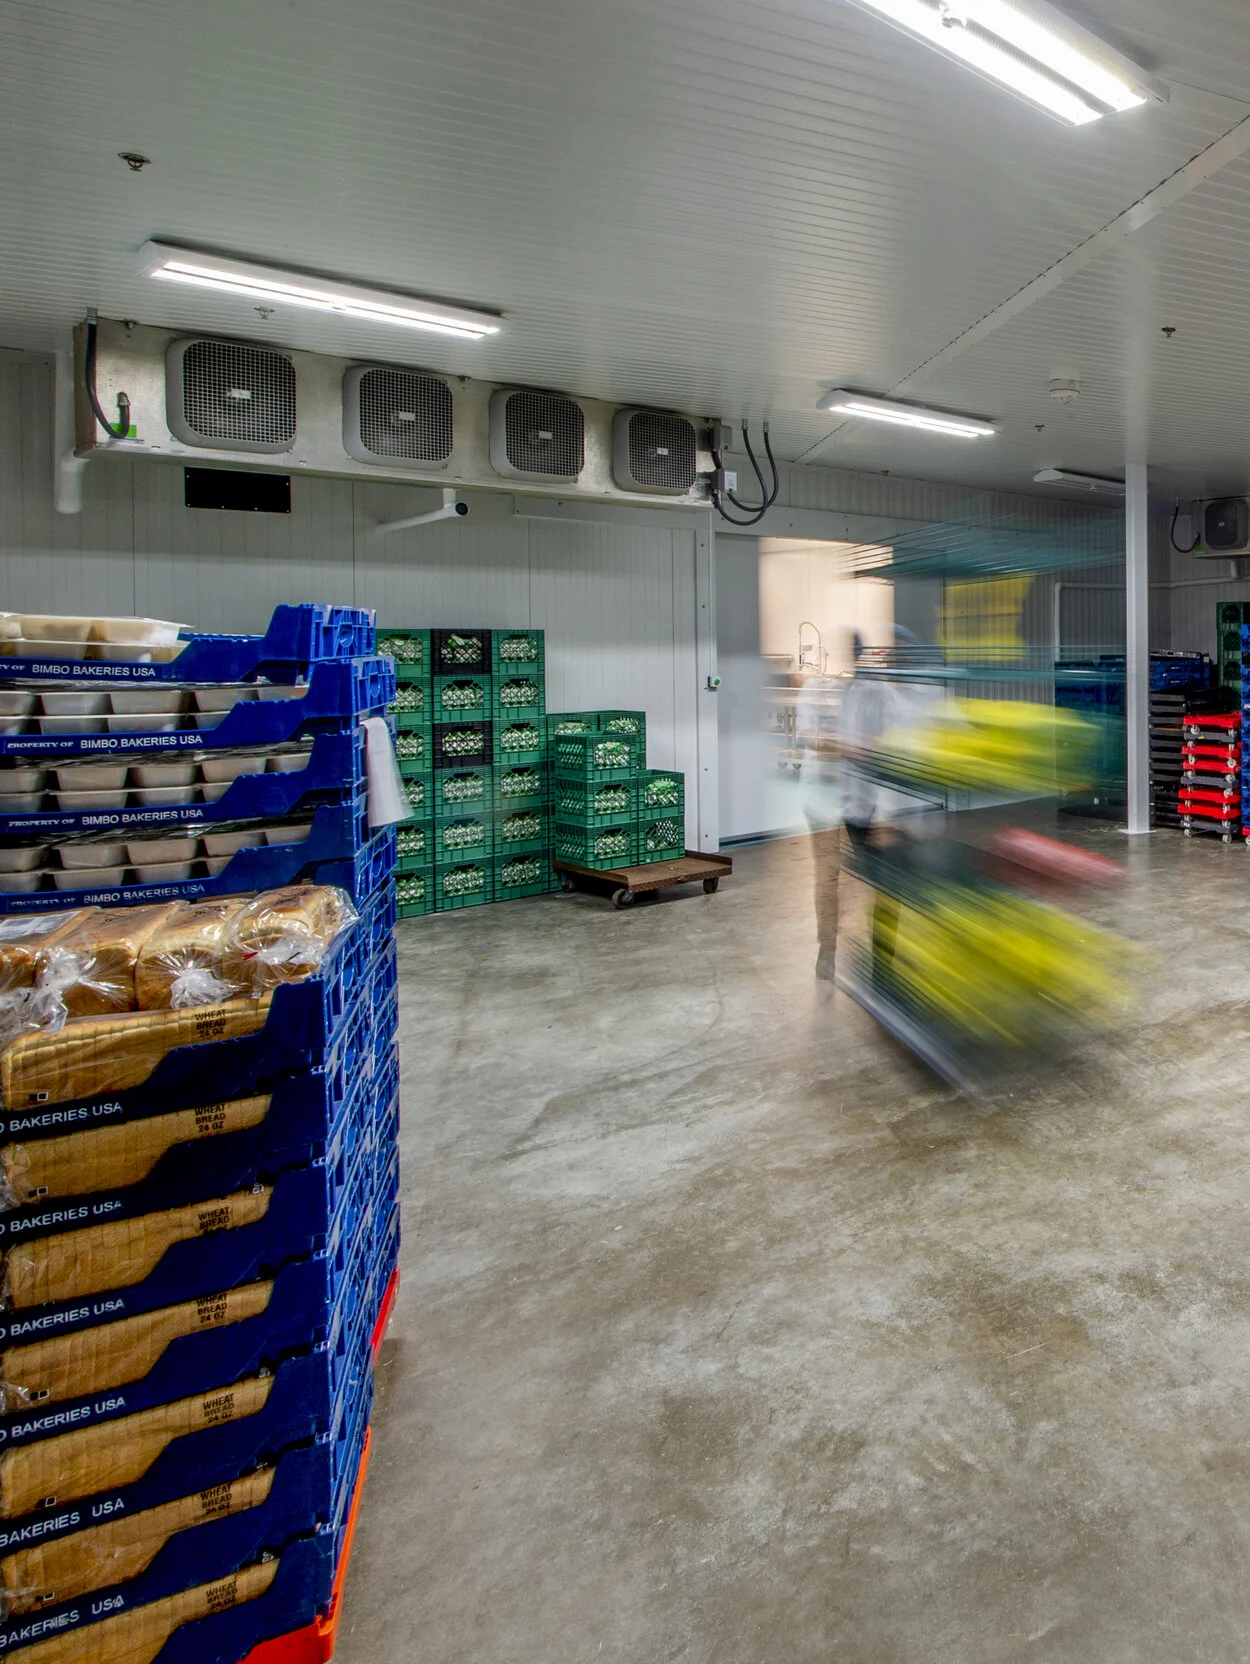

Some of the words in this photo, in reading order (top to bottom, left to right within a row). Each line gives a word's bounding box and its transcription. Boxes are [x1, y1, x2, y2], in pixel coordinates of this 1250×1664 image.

[32, 664, 70, 675] BIMBO
[73, 665, 130, 676] BAKERIES
[132, 667, 156, 677] USA
[80, 738, 118, 749] BIMBO
[121, 736, 177, 748] BAKERIES
[179, 735, 203, 745] USA
[8, 819, 60, 827] PROPERTY
[82, 814, 119, 826] BIMBO
[122, 811, 178, 823] BAKERIES
[180, 809, 204, 819] USA
[83, 892, 120, 904] BIMBO
[123, 887, 179, 900] BAKERIES
[181, 883, 205, 895] USA
[195, 1009, 226, 1021] WHEAT
[196, 1018, 226, 1030] BREAD
[194, 1103, 226, 1116] WHEAT
[9, 1107, 88, 1132] BAKERIES
[92, 1102, 123, 1116] USA
[195, 1112, 226, 1125] BREAD
[198, 1124, 209, 1133] 24
[212, 1121, 224, 1130] OZ
[10, 1206, 89, 1232] BAKERIES
[93, 1200, 122, 1214] USA
[198, 1206, 229, 1220] WHEAT
[200, 1215, 230, 1229] BREAD
[196, 1293, 228, 1307] WHEAT
[197, 1302, 228, 1316] BREAD
[10, 1307, 90, 1336] BAKERIES
[93, 1298, 125, 1315] USA
[200, 1314, 211, 1324] 24
[213, 1311, 226, 1319] OZ
[203, 1393, 234, 1410] WHEAT
[11, 1406, 91, 1439] BAKERIES
[94, 1396, 126, 1414] USA
[200, 1483, 231, 1501] WHEAT
[0, 1511, 80, 1547] BAKERIES
[92, 1498, 125, 1517] USA
[0, 1610, 80, 1648] BAKERIES
[91, 1595, 125, 1615] USA
